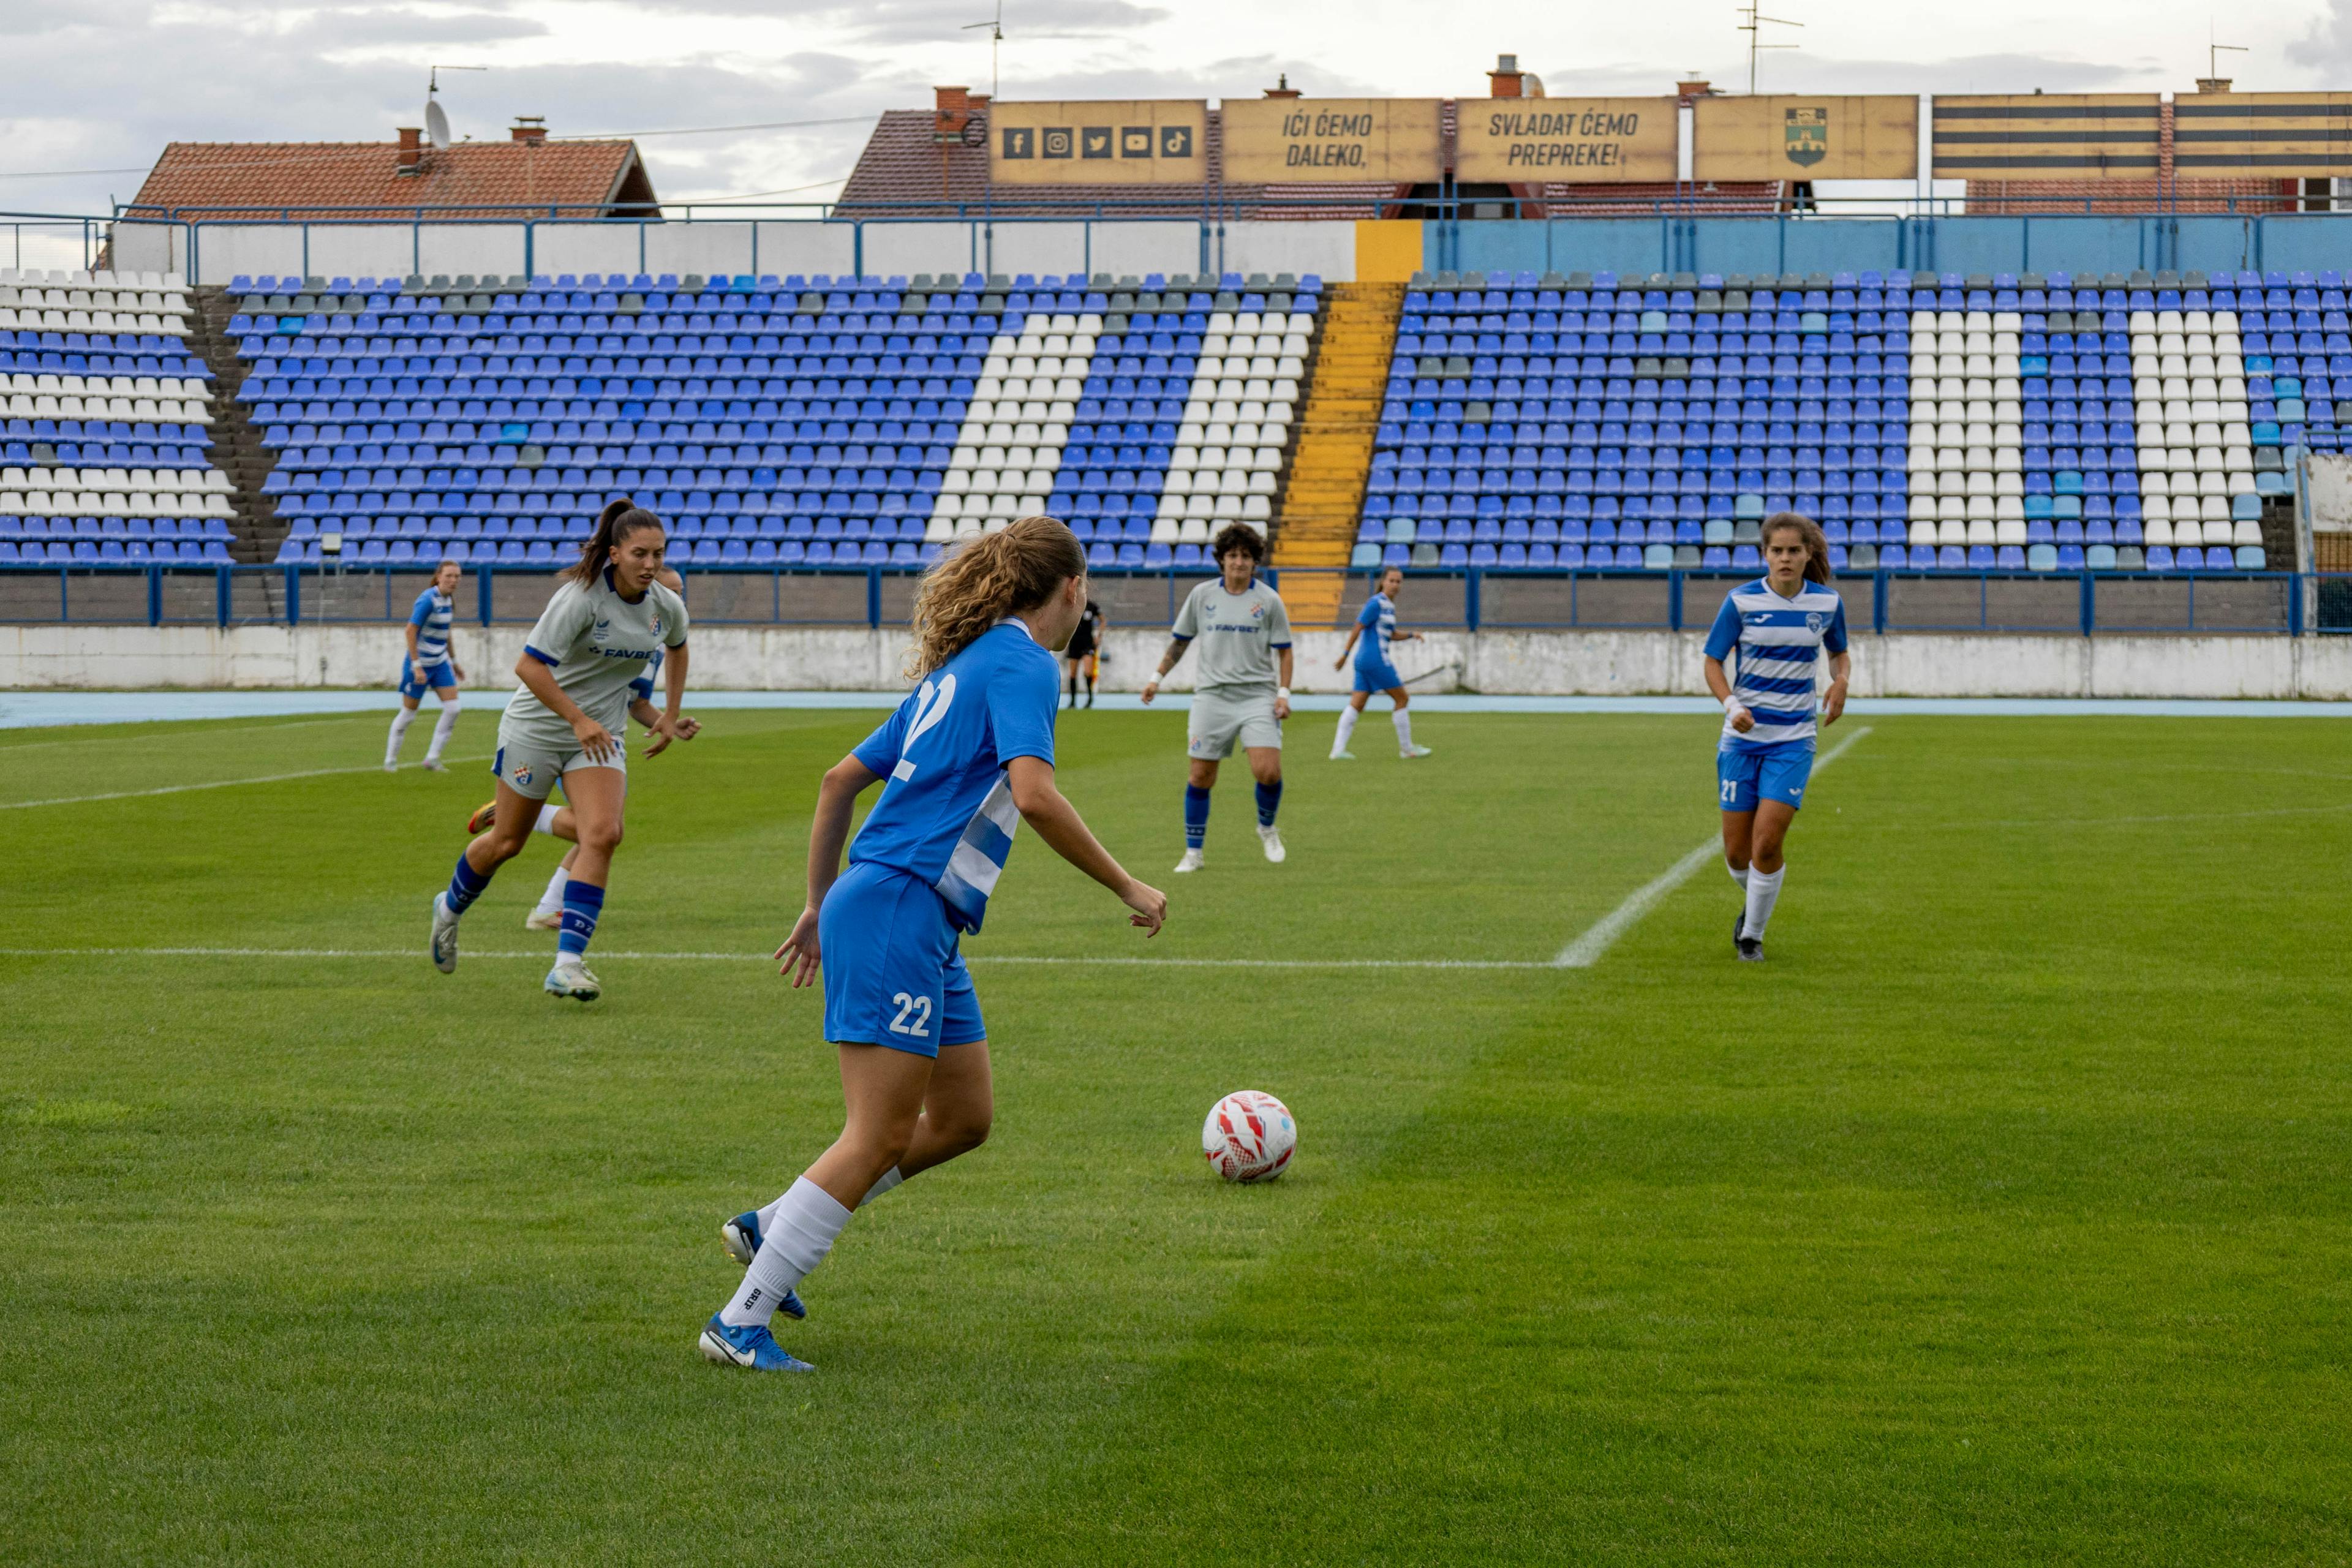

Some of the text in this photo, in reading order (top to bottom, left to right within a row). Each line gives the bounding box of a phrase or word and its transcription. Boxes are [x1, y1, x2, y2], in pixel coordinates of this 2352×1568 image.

[1283, 108, 1373, 137] IĆI ĆEMO
[1489, 108, 1638, 136] SVLADAT ĆEMO
[1286, 144, 1366, 168] DALEKO,
[1508, 143, 1619, 166] PREPREKE!
[604, 648, 655, 660] FAVBE
[1721, 779, 1738, 803] 21
[889, 992, 932, 1037] 22
[744, 1288, 761, 1310] GRIP
